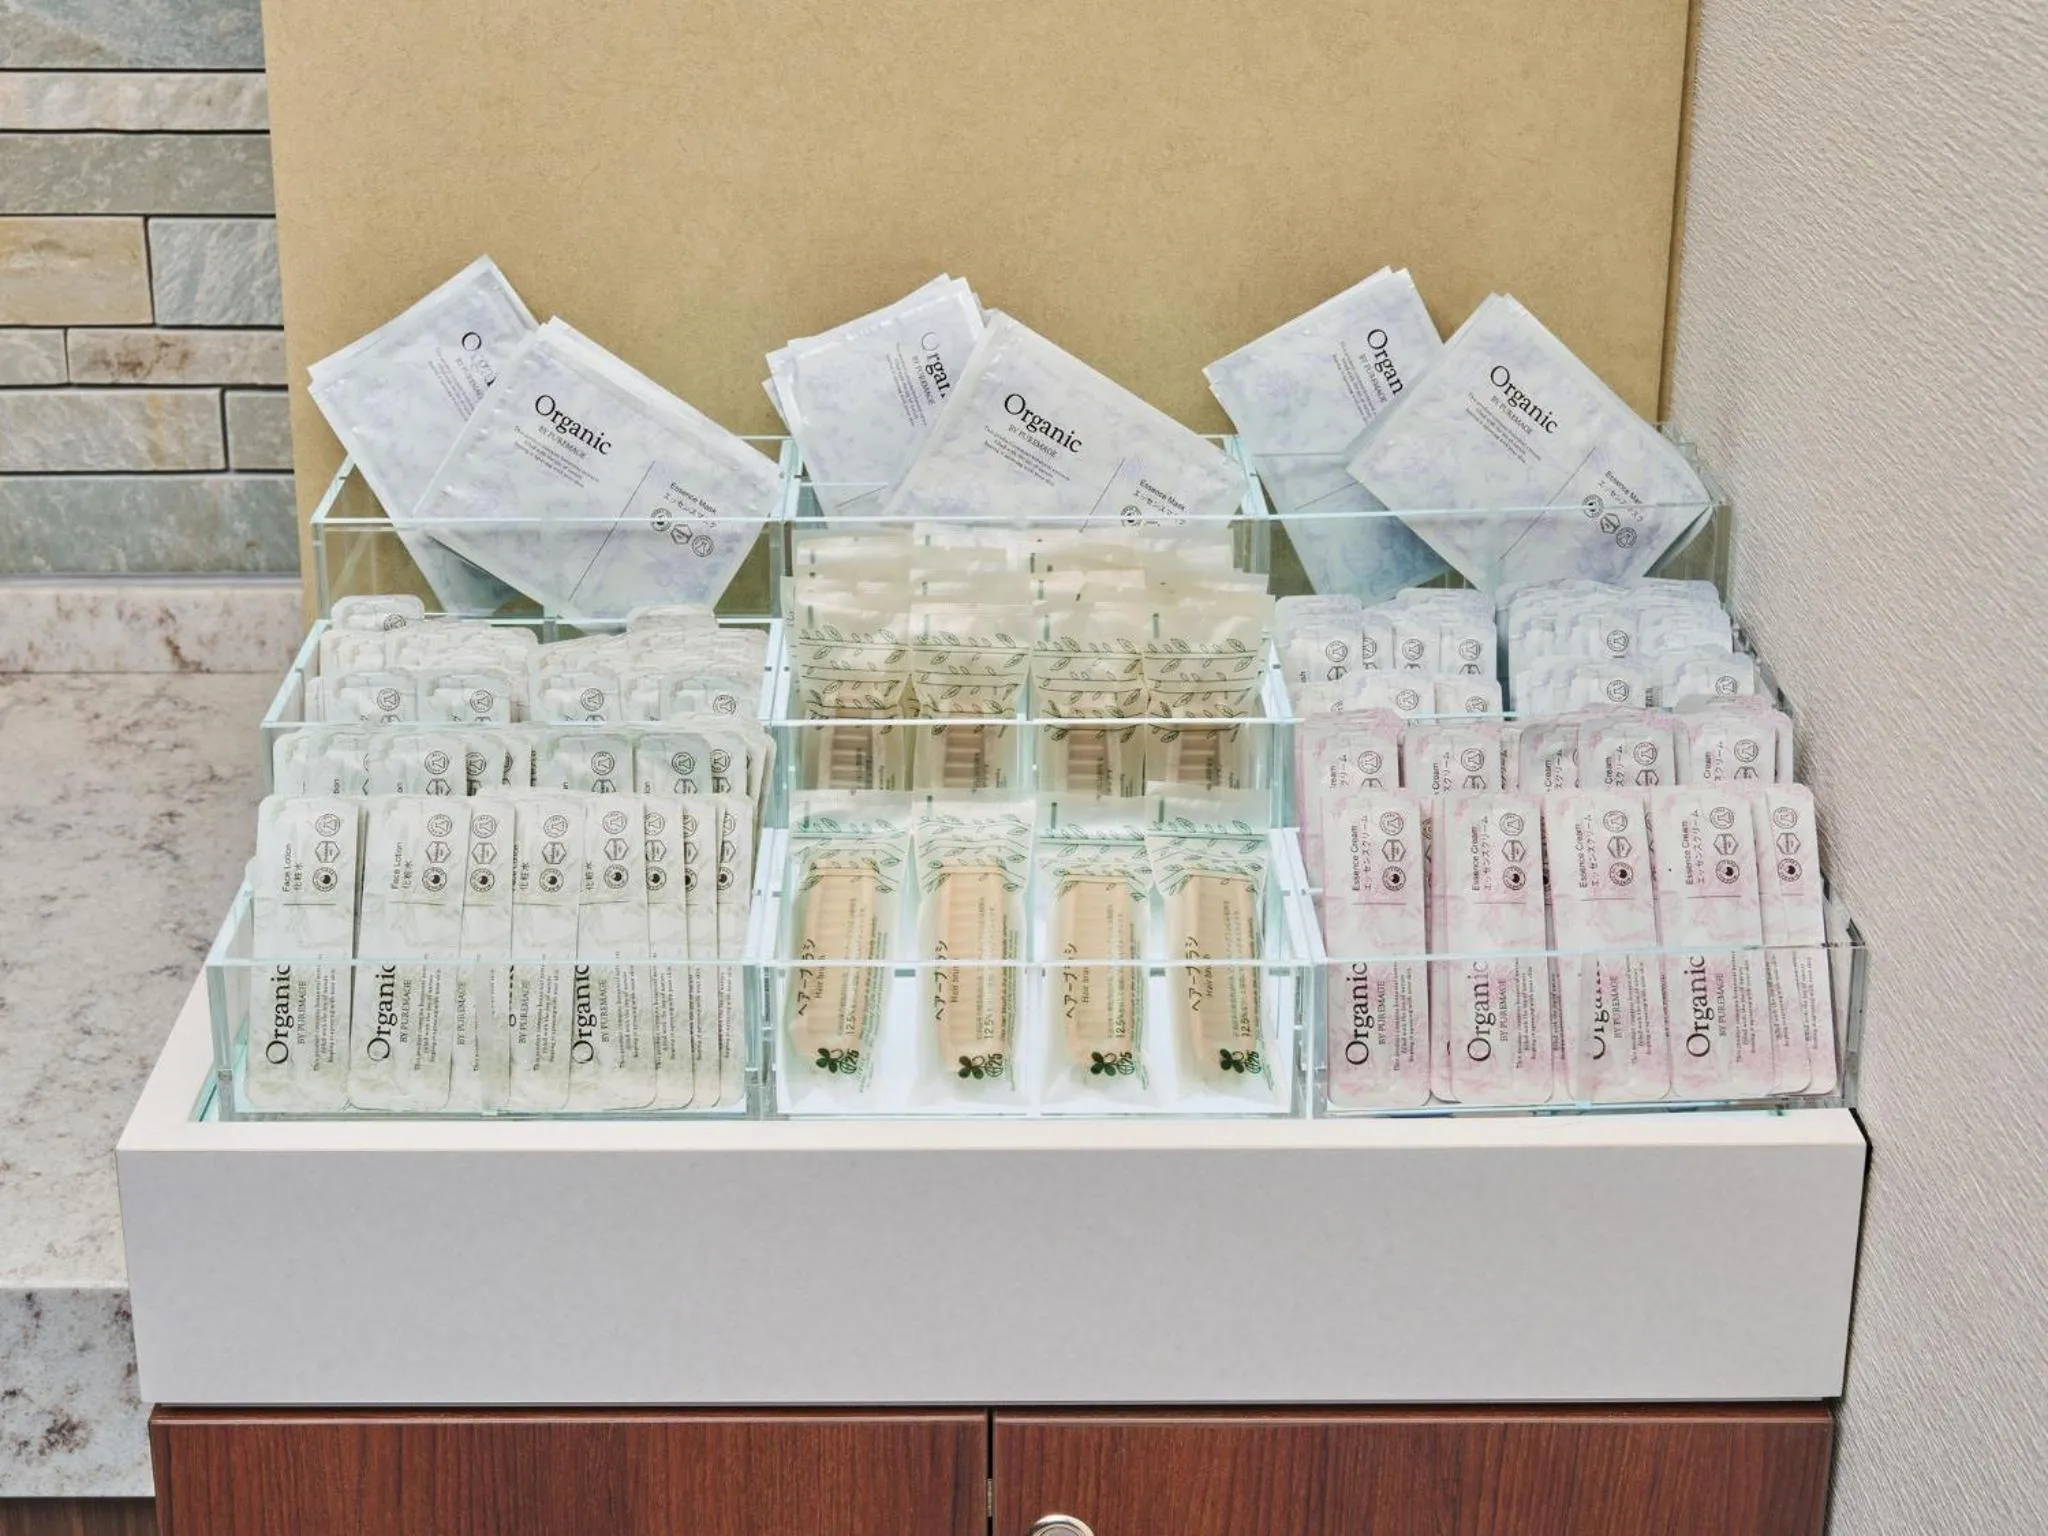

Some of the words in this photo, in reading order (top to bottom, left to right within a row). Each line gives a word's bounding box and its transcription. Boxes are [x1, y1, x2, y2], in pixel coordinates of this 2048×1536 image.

[1367, 328, 1403, 395] Organ
[1490, 365, 1558, 434] Organic
[535, 394, 612, 455] Organic
[1004, 393, 1083, 453] Organic
[1350, 825, 1359, 853] Cream
[1470, 826, 1478, 854] Cream
[1575, 823, 1584, 851] Cream
[1681, 820, 1690, 849] Cream
[393, 841, 403, 868] Lotion
[1684, 849, 1694, 885] Essence
[391, 869, 400, 890] Face
[1352, 855, 1361, 891] Essence
[1471, 855, 1480, 891] Essence
[1577, 852, 1587, 888] Essence
[265, 964, 294, 1065] Organic
[366, 964, 398, 1061] Organic
[570, 964, 597, 1064] Organic
[1344, 963, 1374, 1066] Organic
[1466, 961, 1496, 1062] Organic
[1686, 956, 1715, 1058] Organic
[297, 1033, 306, 1044] BY
[399, 1032, 408, 1043] BY
[456, 1035, 465, 1045] BY
[518, 1032, 527, 1044] BY
[601, 1032, 609, 1042] BY
[1378, 1033, 1386, 1045] BY
[1499, 1029, 1508, 1042] BY
[1613, 1026, 1622, 1038] BY
[1718, 1025, 1727, 1037] BY
